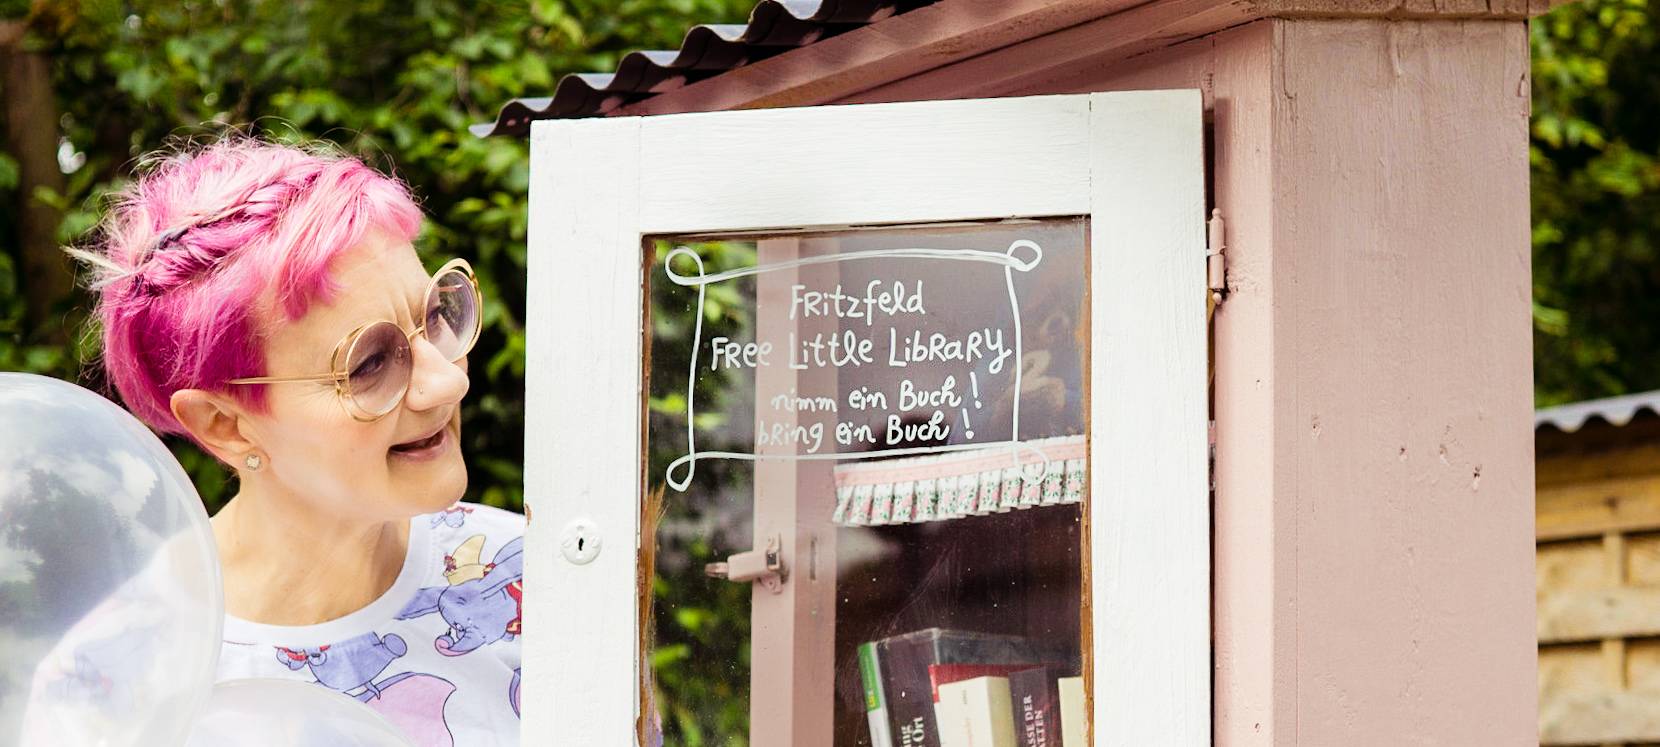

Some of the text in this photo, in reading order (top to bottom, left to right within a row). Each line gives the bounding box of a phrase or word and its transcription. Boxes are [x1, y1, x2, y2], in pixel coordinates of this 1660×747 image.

[789, 329, 873, 370] Little
[771, 389, 838, 413] nimm
[848, 386, 888, 410] ein
[899, 375, 962, 411] Buch
[835, 423, 877, 445] ein
[886, 410, 950, 445] Buch
[1023, 694, 1034, 721] DER
